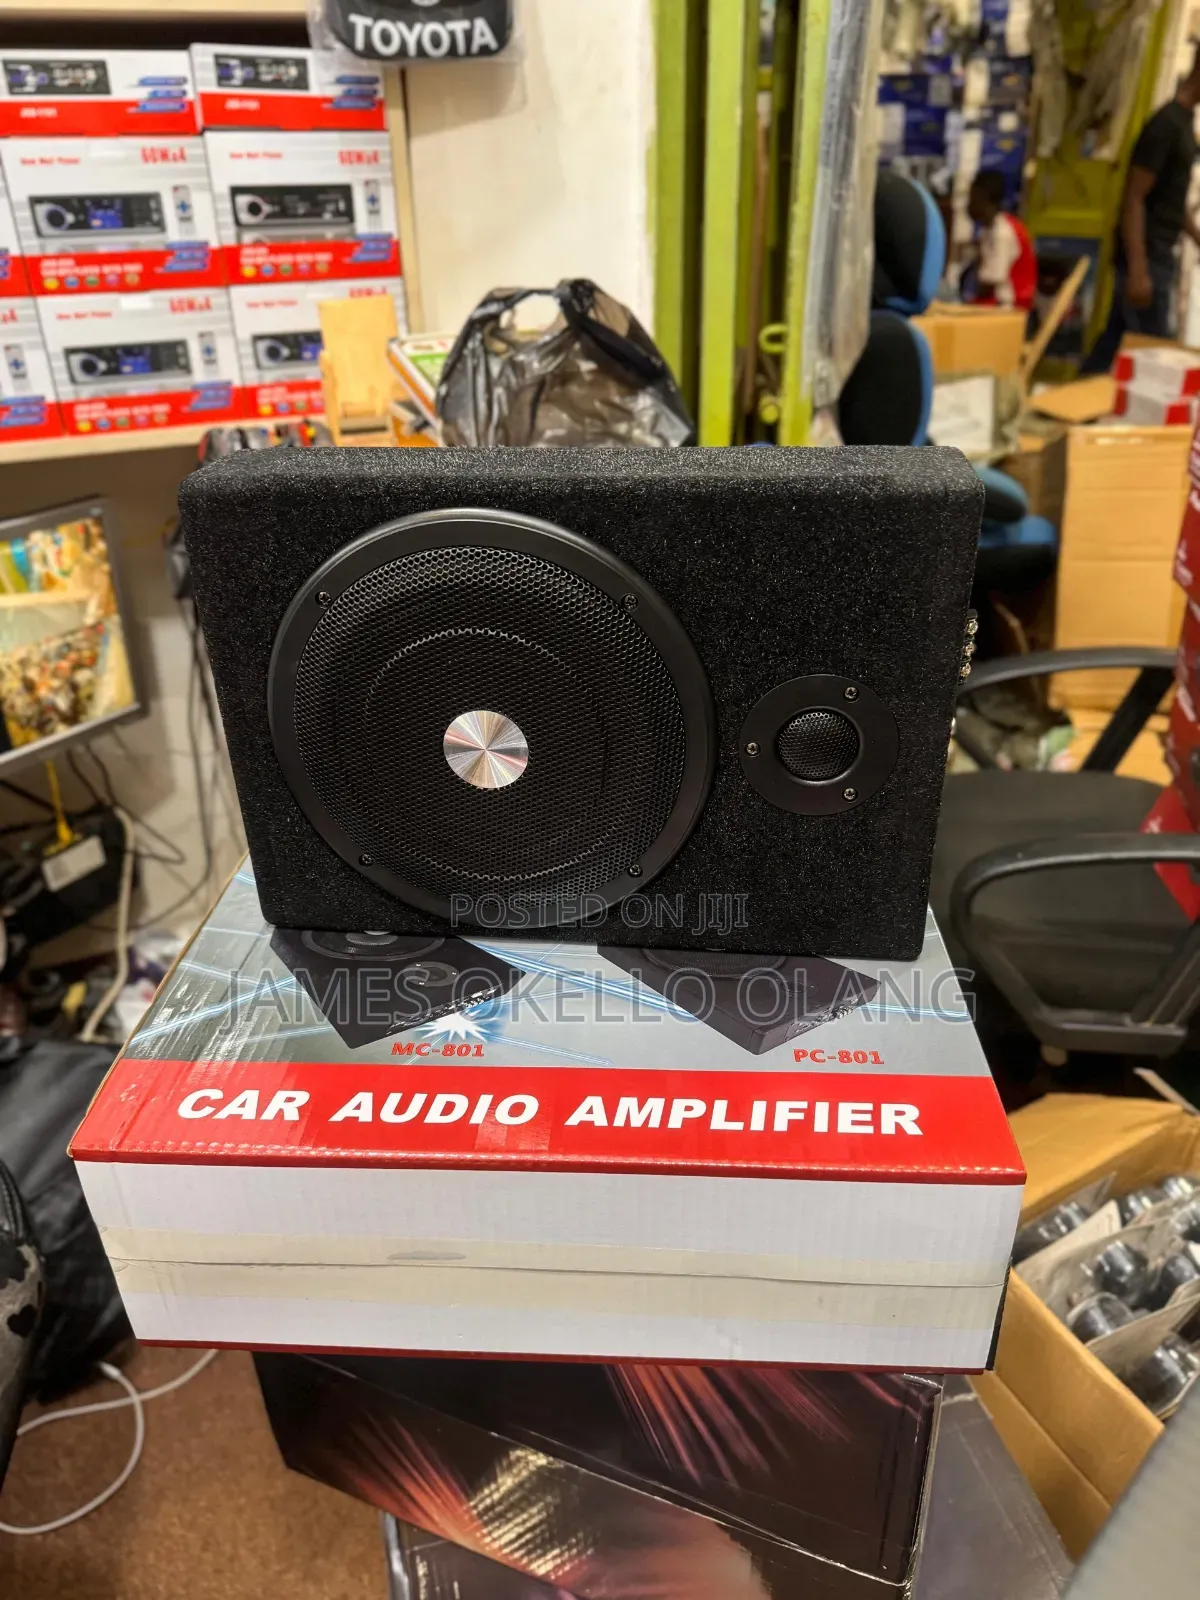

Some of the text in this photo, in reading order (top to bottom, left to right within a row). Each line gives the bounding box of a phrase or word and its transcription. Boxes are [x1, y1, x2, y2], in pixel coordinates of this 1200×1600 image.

[348, 13, 499, 57] TOYOTA
[391, 1042, 485, 1058] MC-801
[793, 1049, 885, 1065] PC-801
[177, 1088, 924, 1136] CAR AUDIO AMPLIFIER
